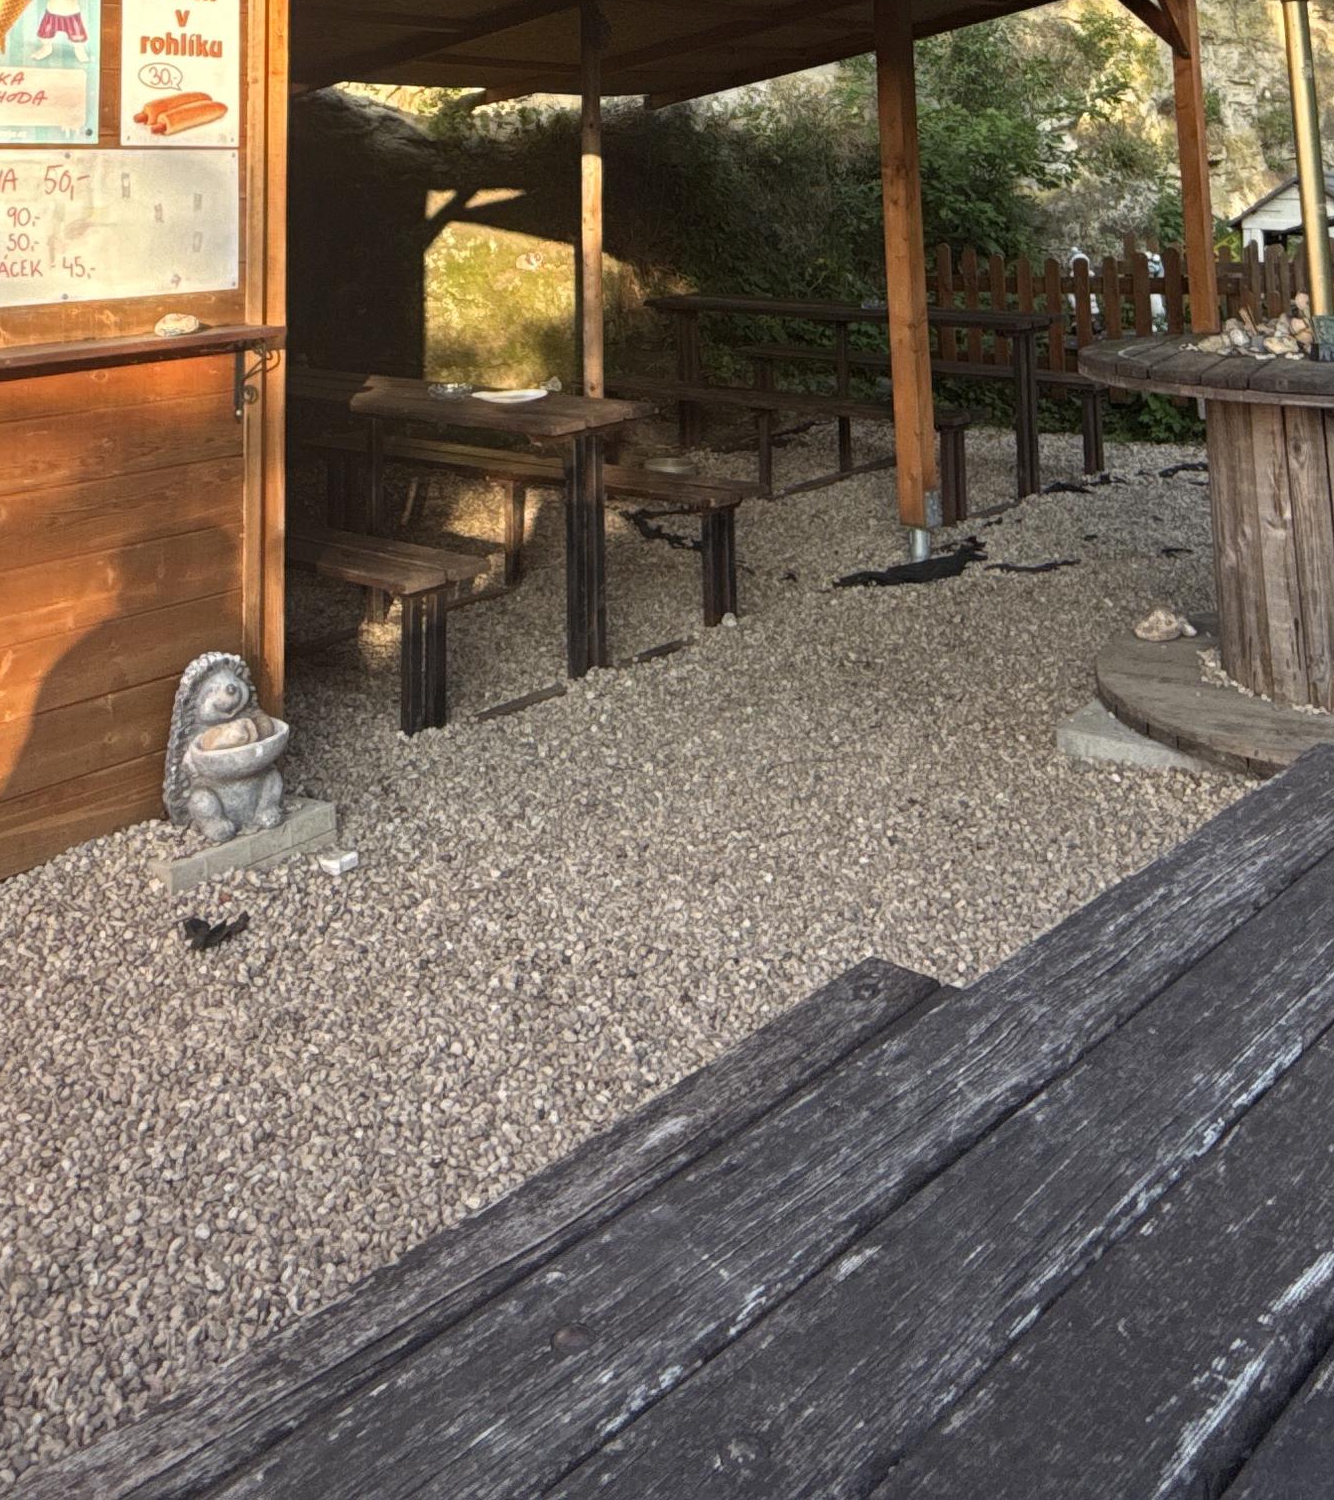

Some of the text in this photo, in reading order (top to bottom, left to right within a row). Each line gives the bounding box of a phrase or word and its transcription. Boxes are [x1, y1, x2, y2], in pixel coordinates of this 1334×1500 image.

[175, 9, 190, 27] v
[140, 32, 223, 58] rohlíku
[43, 164, 91, 200] 50,-
[6, 206, 41, 227] 90,-
